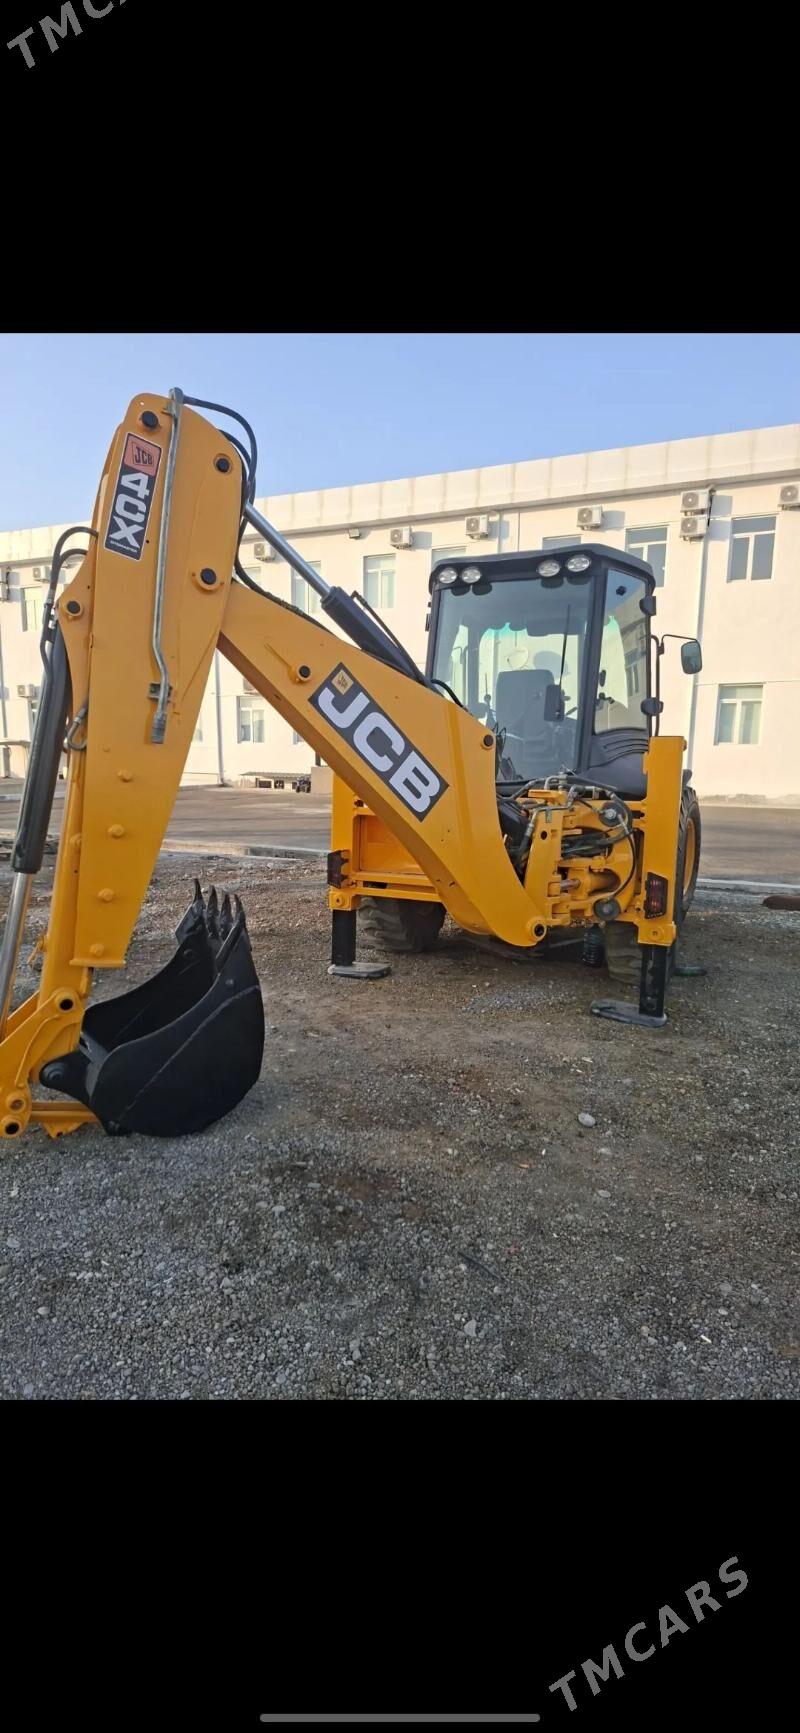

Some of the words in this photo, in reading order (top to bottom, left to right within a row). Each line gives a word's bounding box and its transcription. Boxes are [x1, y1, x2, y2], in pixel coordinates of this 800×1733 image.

[135, 446, 153, 465] JCB
[108, 472, 150, 549] 4CX
[318, 687, 440, 813] JCB
